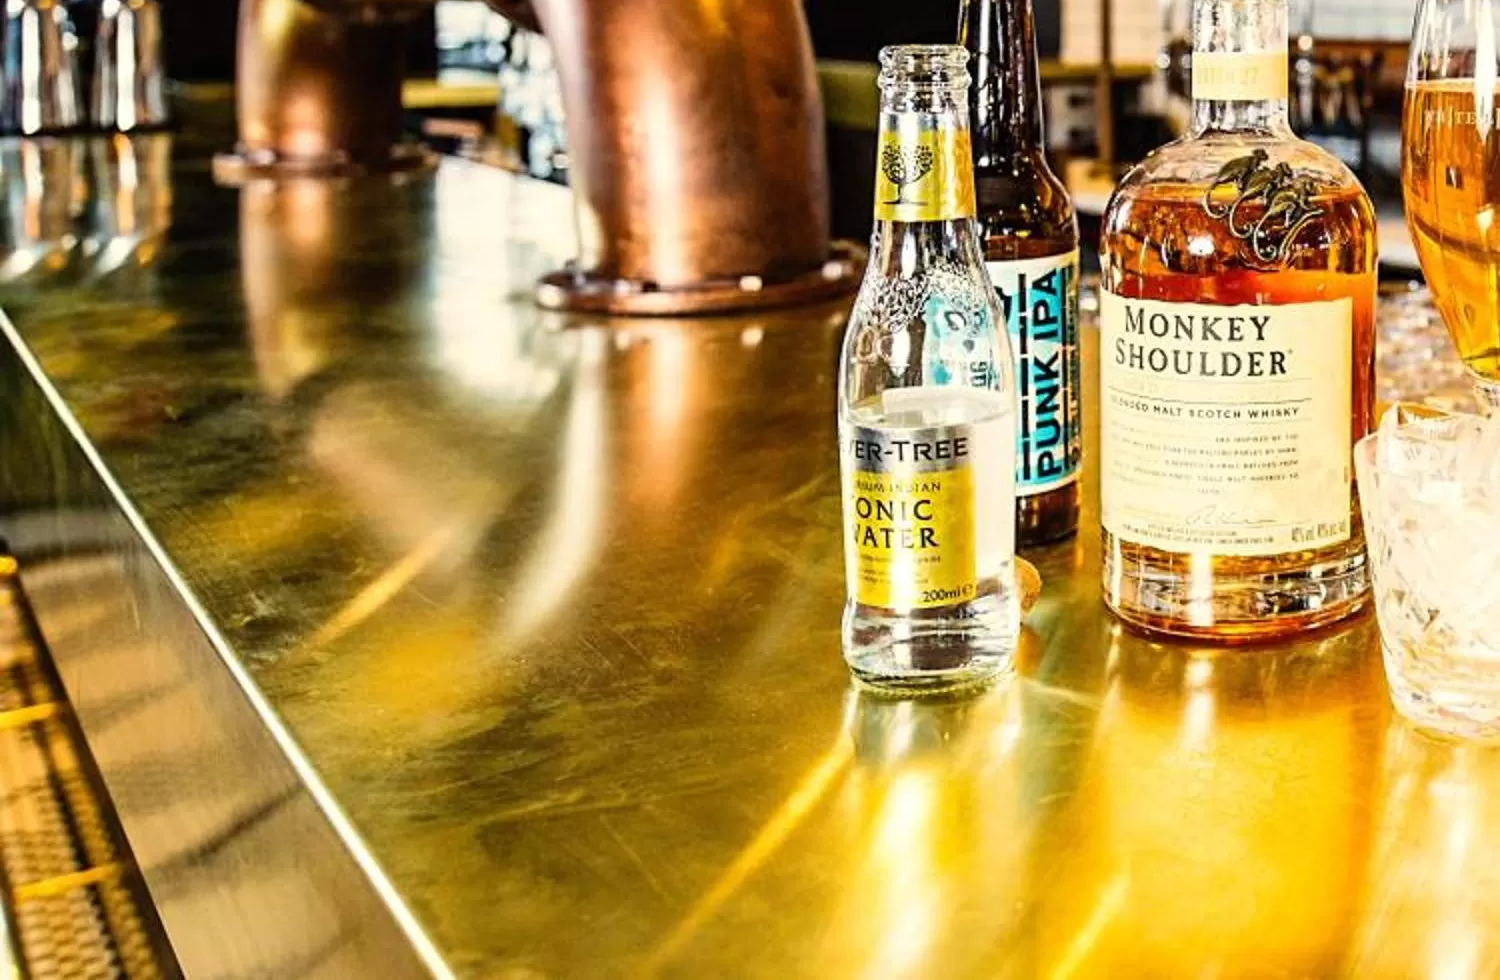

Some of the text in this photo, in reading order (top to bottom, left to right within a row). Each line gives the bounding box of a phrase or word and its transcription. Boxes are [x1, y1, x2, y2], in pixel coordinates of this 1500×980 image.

[1125, 305, 1271, 342] MONKEY
[1115, 338, 1288, 377] SHOULDER
[1032, 268, 1063, 479] PUNK IPA
[1153, 404, 1182, 417] MALT
[1189, 408, 1241, 419] SCOTCH
[1247, 407, 1299, 419] WHISKY
[853, 496, 933, 522] ONIC
[923, 585, 961, 603] 200ml
